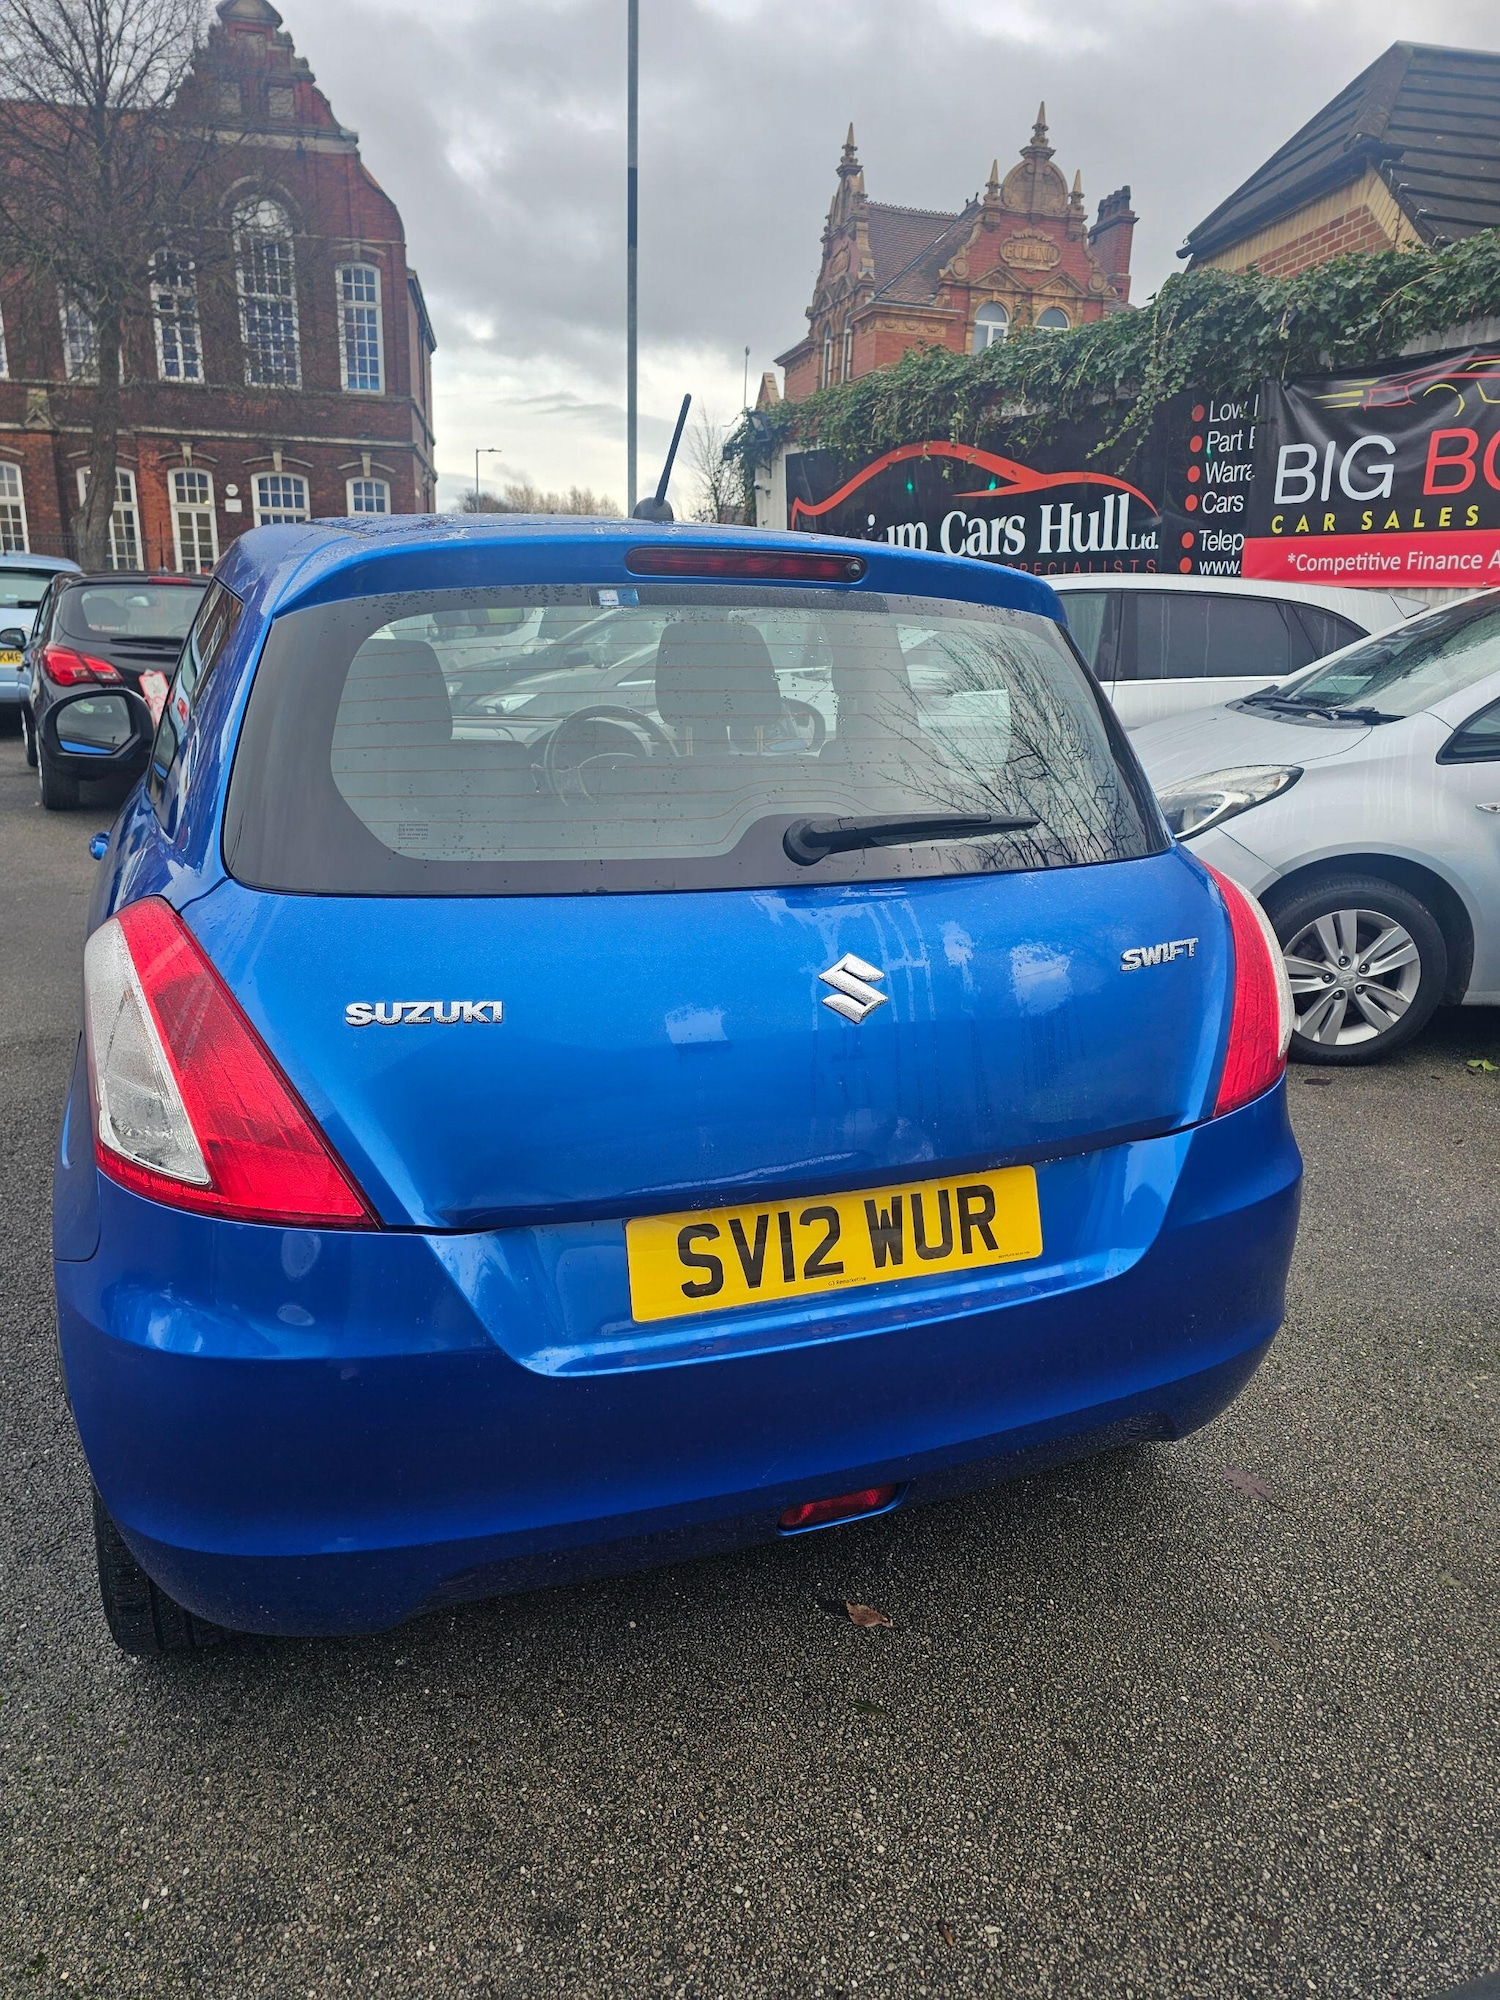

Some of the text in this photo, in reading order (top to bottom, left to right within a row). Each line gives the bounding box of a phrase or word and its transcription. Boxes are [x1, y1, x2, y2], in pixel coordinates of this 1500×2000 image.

[1207, 429, 1244, 453] Part
[1274, 435, 1396, 504] BIG
[1202, 491, 1244, 514] Cars
[940, 510, 1026, 556] Cars
[1038, 492, 1130, 553] Hull
[1131, 531, 1159, 550] Ltd.
[1272, 505, 1479, 534] CAR SALES
[1199, 529, 1245, 556] Telep
[1407, 551, 1483, 570] Finance
[1121, 938, 1199, 971] SWIFT
[345, 1001, 502, 1026] SUZUKI
[677, 1184, 1000, 1299] SV12 WUR
